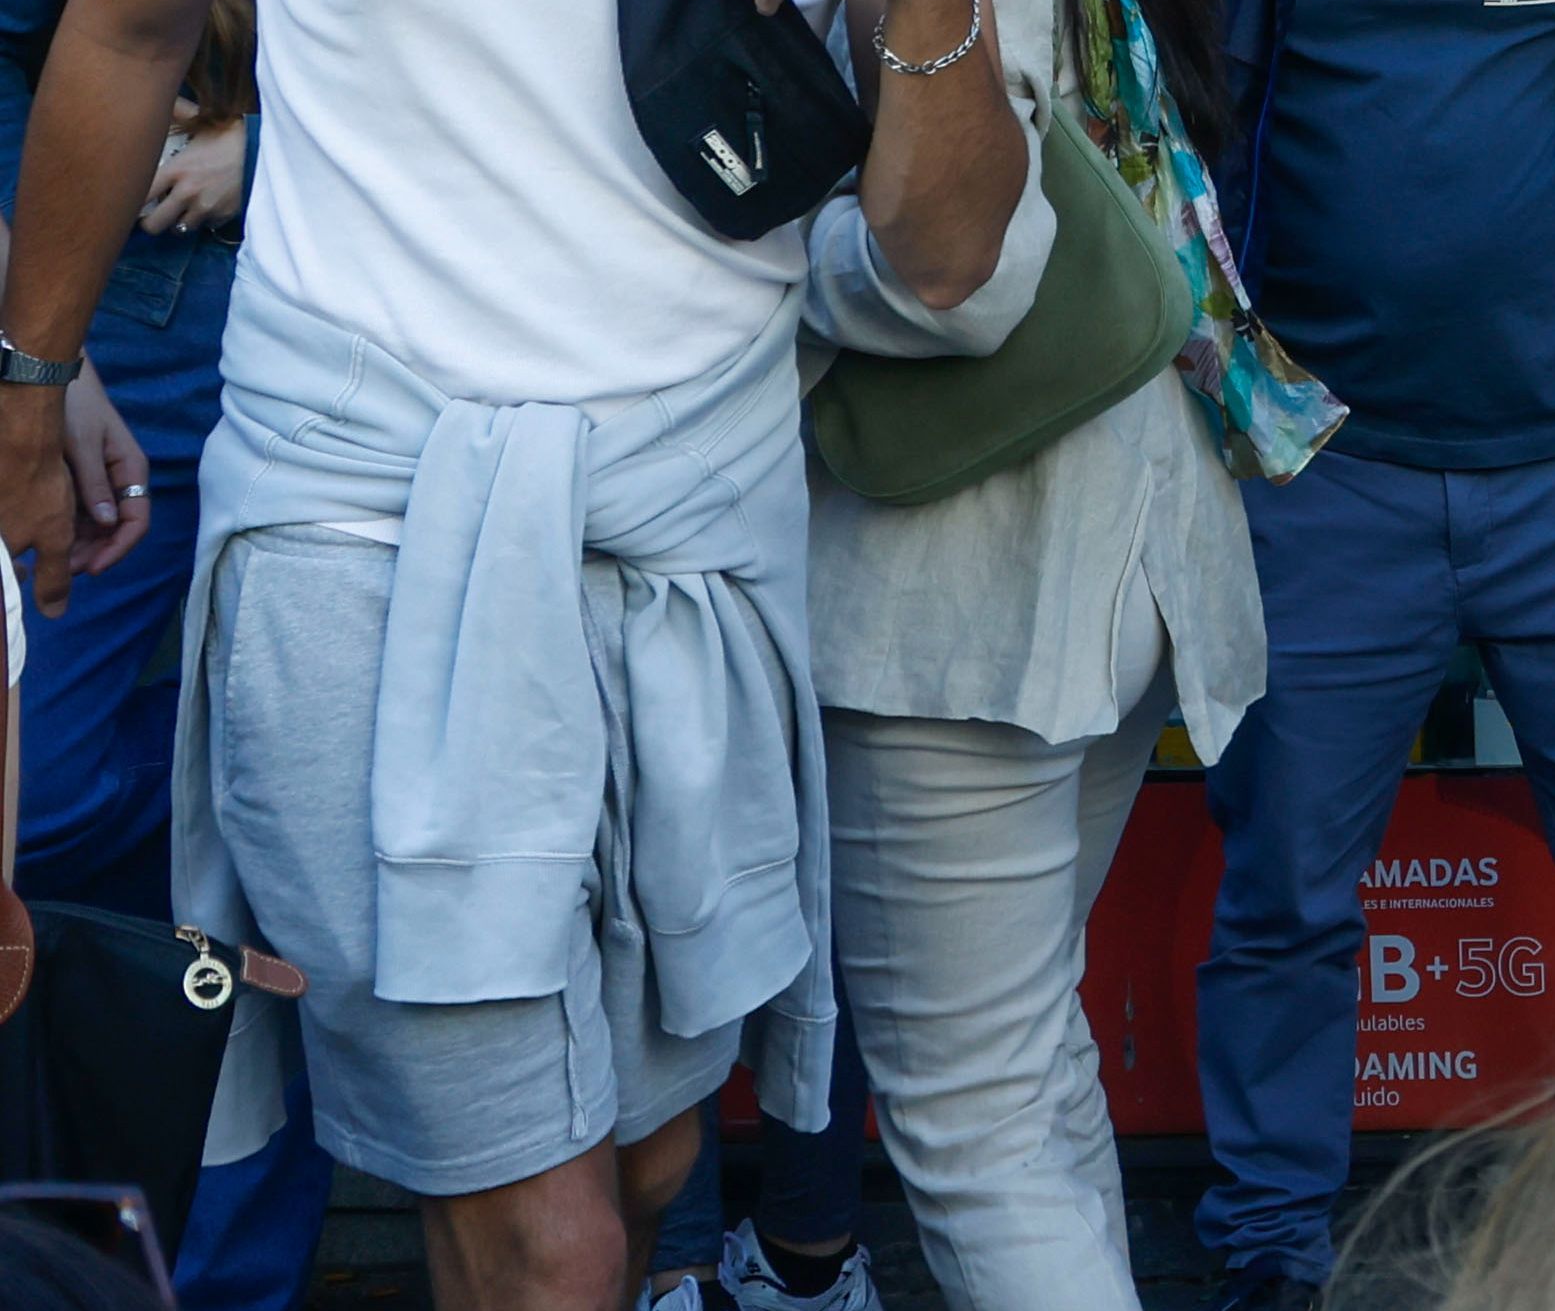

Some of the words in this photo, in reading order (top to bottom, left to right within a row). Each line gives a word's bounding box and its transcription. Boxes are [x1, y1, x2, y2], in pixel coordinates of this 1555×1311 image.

[1361, 899, 1378, 911] ES
[1380, 899, 1387, 910] E
[1389, 896, 1495, 911] INTERNACIONALES
[1357, 1014, 1426, 1032] ulables
[1355, 1050, 1478, 1081] AMING
